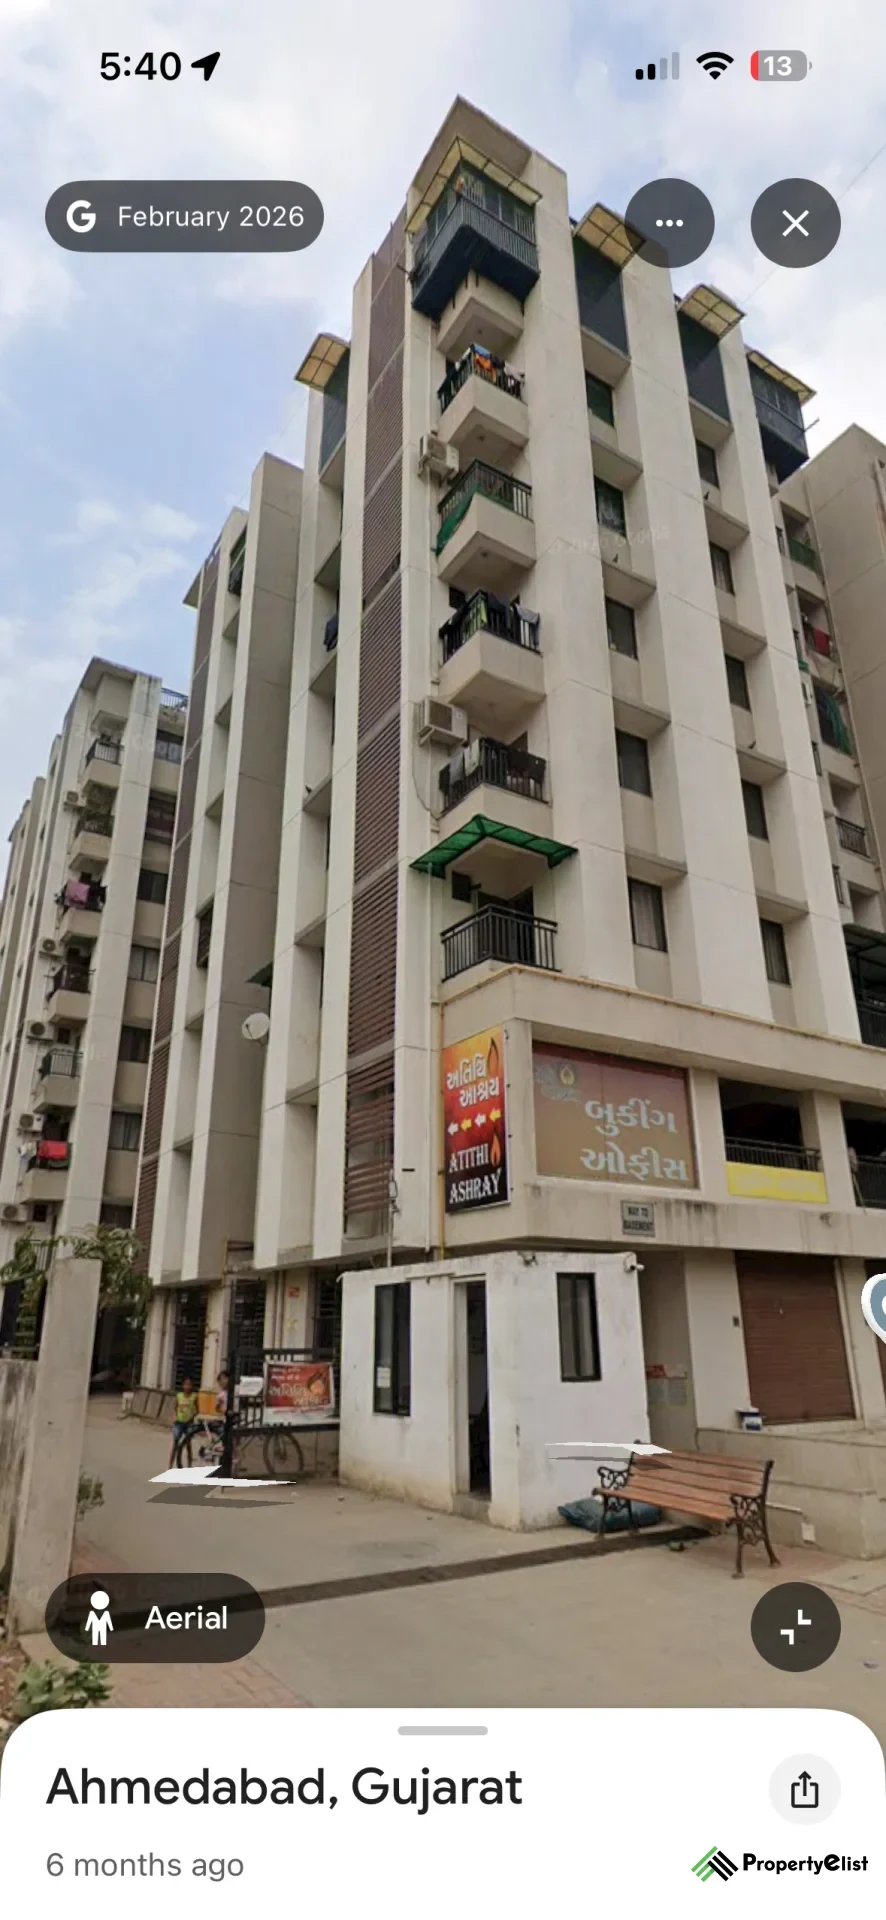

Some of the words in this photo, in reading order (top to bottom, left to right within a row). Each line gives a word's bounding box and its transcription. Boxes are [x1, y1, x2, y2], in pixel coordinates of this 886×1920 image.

[447, 1053, 487, 1090] અતિથિ
[459, 1076, 501, 1108] આશ્રય
[584, 1097, 679, 1137] બુકીંગ
[449, 1143, 490, 1173] ATITHI
[580, 1141, 689, 1181] ઓફીસ
[449, 1167, 503, 1204] ASHRAY
